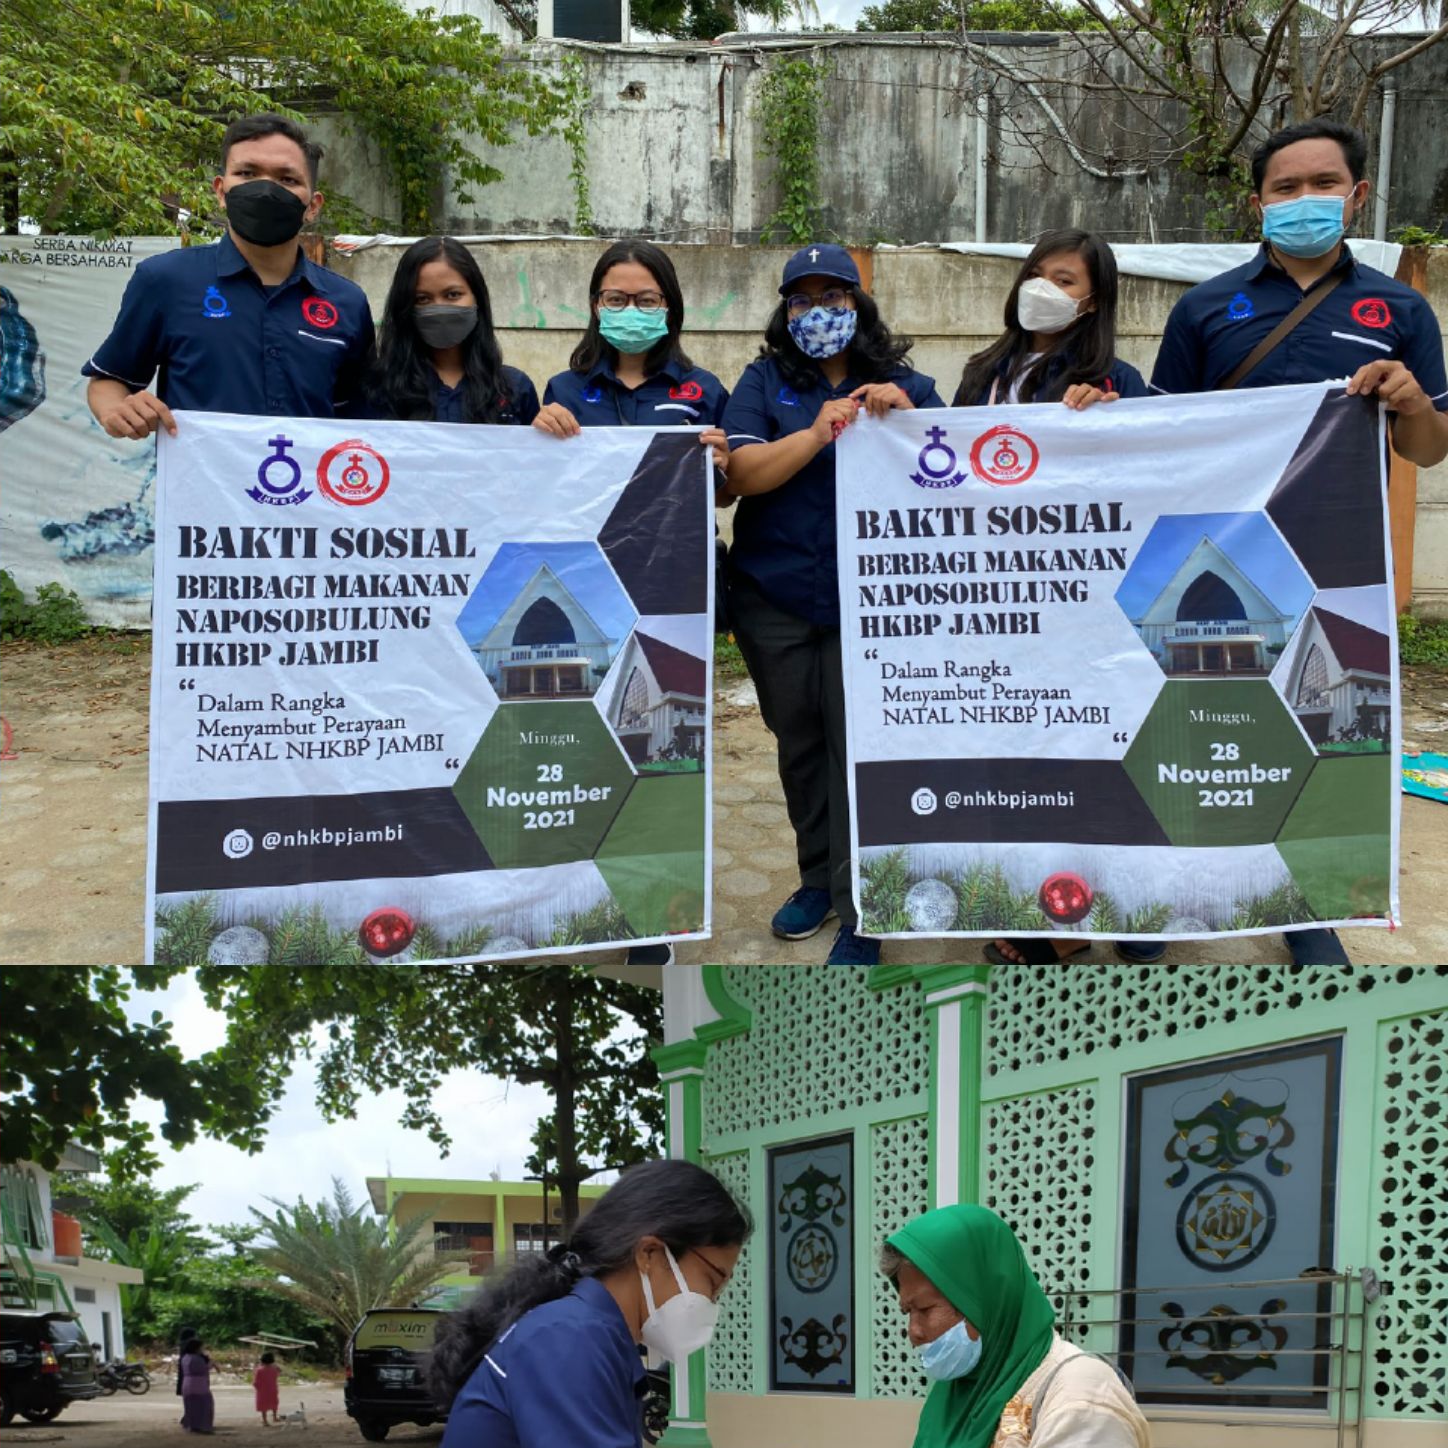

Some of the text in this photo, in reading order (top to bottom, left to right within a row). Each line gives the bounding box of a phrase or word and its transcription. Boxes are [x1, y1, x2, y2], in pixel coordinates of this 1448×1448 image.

[33, 238, 132, 253] SERBA NIKMAT
[47, 253, 132, 268] BERSAHABAT
[856, 502, 1132, 540] BAKTI SOSIAL
[178, 525, 476, 559] BAKTI SOSIAL
[858, 548, 1127, 576] BERBAGI MAKANAN
[176, 573, 470, 600] BERBAGI MAKANAN
[859, 581, 1089, 607] NAPOSOBULUNG
[176, 606, 431, 634] NAPOSOBULUNG
[860, 612, 1041, 638] HKBP JAMBI
[176, 640, 379, 668] HKBP JAMBI
[881, 661, 1011, 682] Dalam Rangka
[197, 694, 345, 715] Dalam Rangka
[882, 685, 1071, 707] Menyambut Perayaan
[197, 716, 406, 741] Menyambut Perayaan
[883, 707, 1110, 728] NATAL NHKBP JAMBI
[1189, 709, 1257, 726] Minggu,
[197, 735, 444, 762] NATAL NHKBP JAMBI
[519, 731, 580, 747] Minggu,
[1210, 744, 1239, 760] 28
[537, 765, 563, 782] 28
[1158, 763, 1291, 785] November
[487, 785, 611, 807] November
[944, 790, 1075, 811] @nhkbpjambi
[1198, 789, 1253, 807] 2021
[524, 810, 575, 830] 2021
[262, 824, 403, 849] @nhkbpjambi
